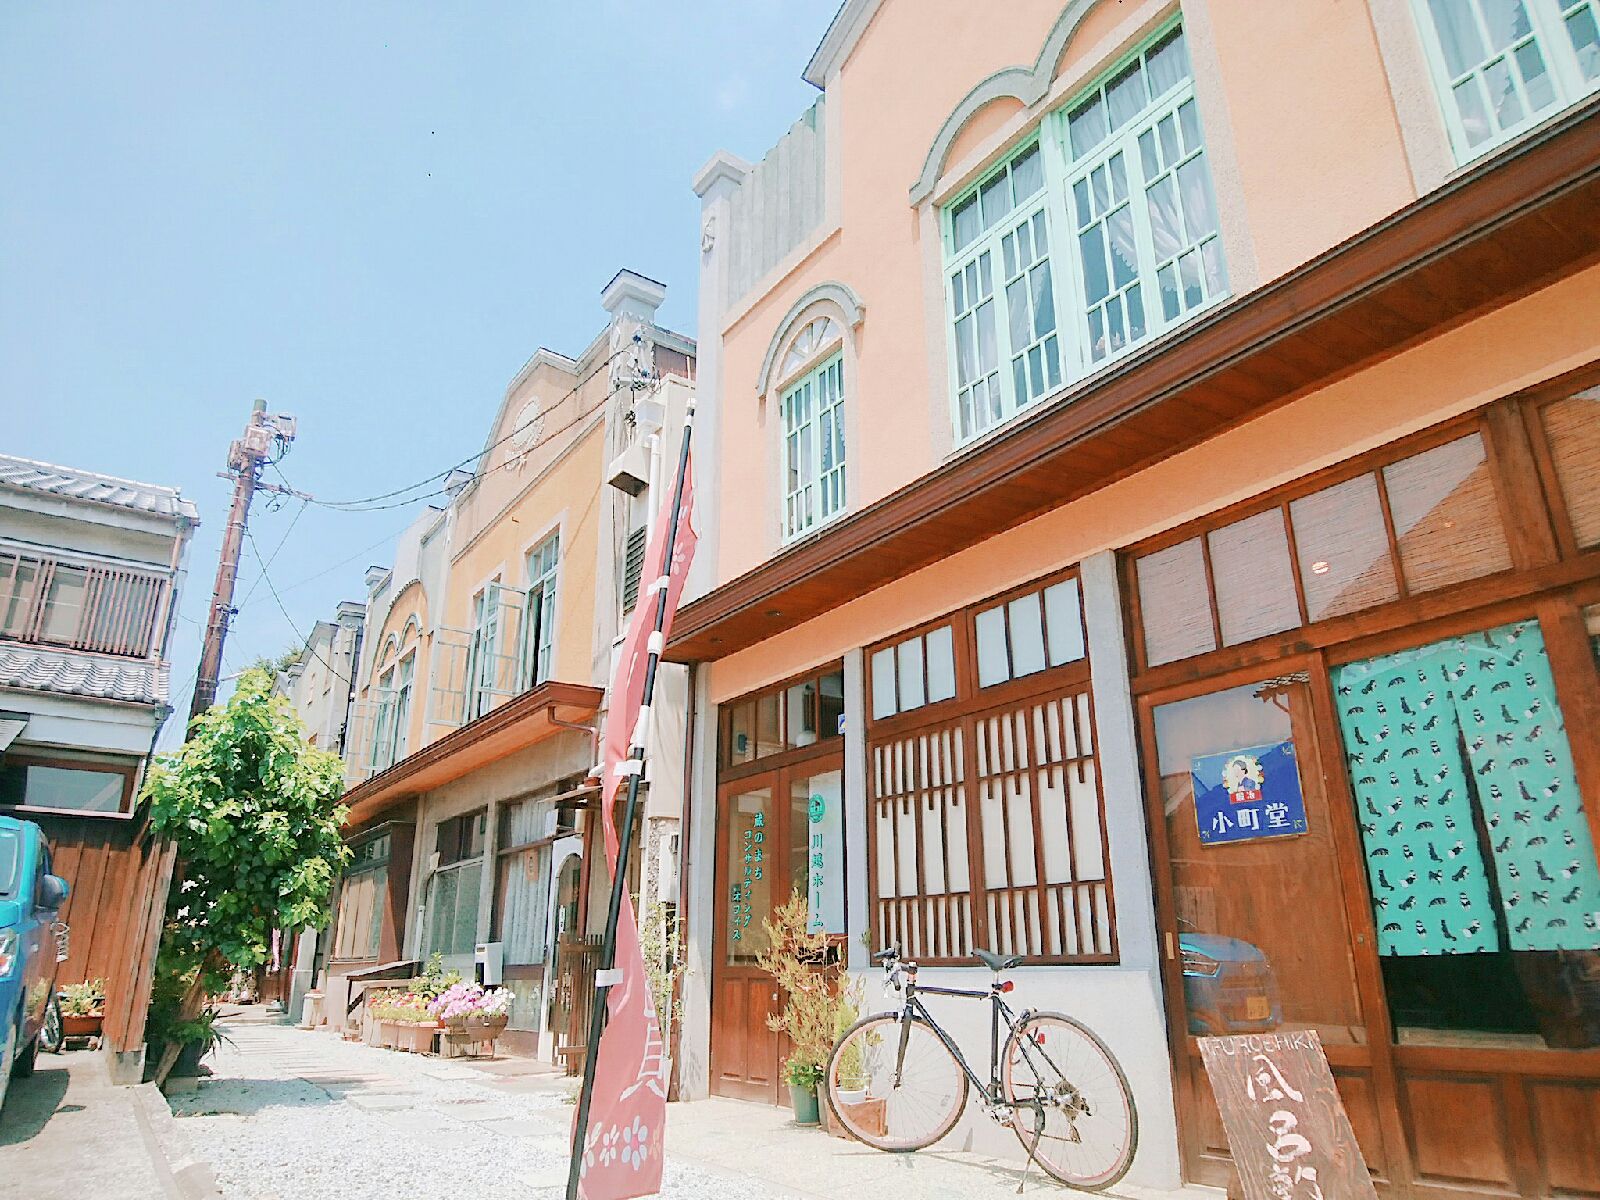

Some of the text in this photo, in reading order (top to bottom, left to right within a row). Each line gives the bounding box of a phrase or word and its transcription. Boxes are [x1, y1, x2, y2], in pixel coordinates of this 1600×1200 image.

[754, 811, 765, 881] 蔵のまち
[1212, 802, 1291, 834] 小町堂
[743, 829, 753, 928] コンサルティング
[811, 833, 824, 927] 川越ホーム
[732, 890, 742, 941] オフィス
